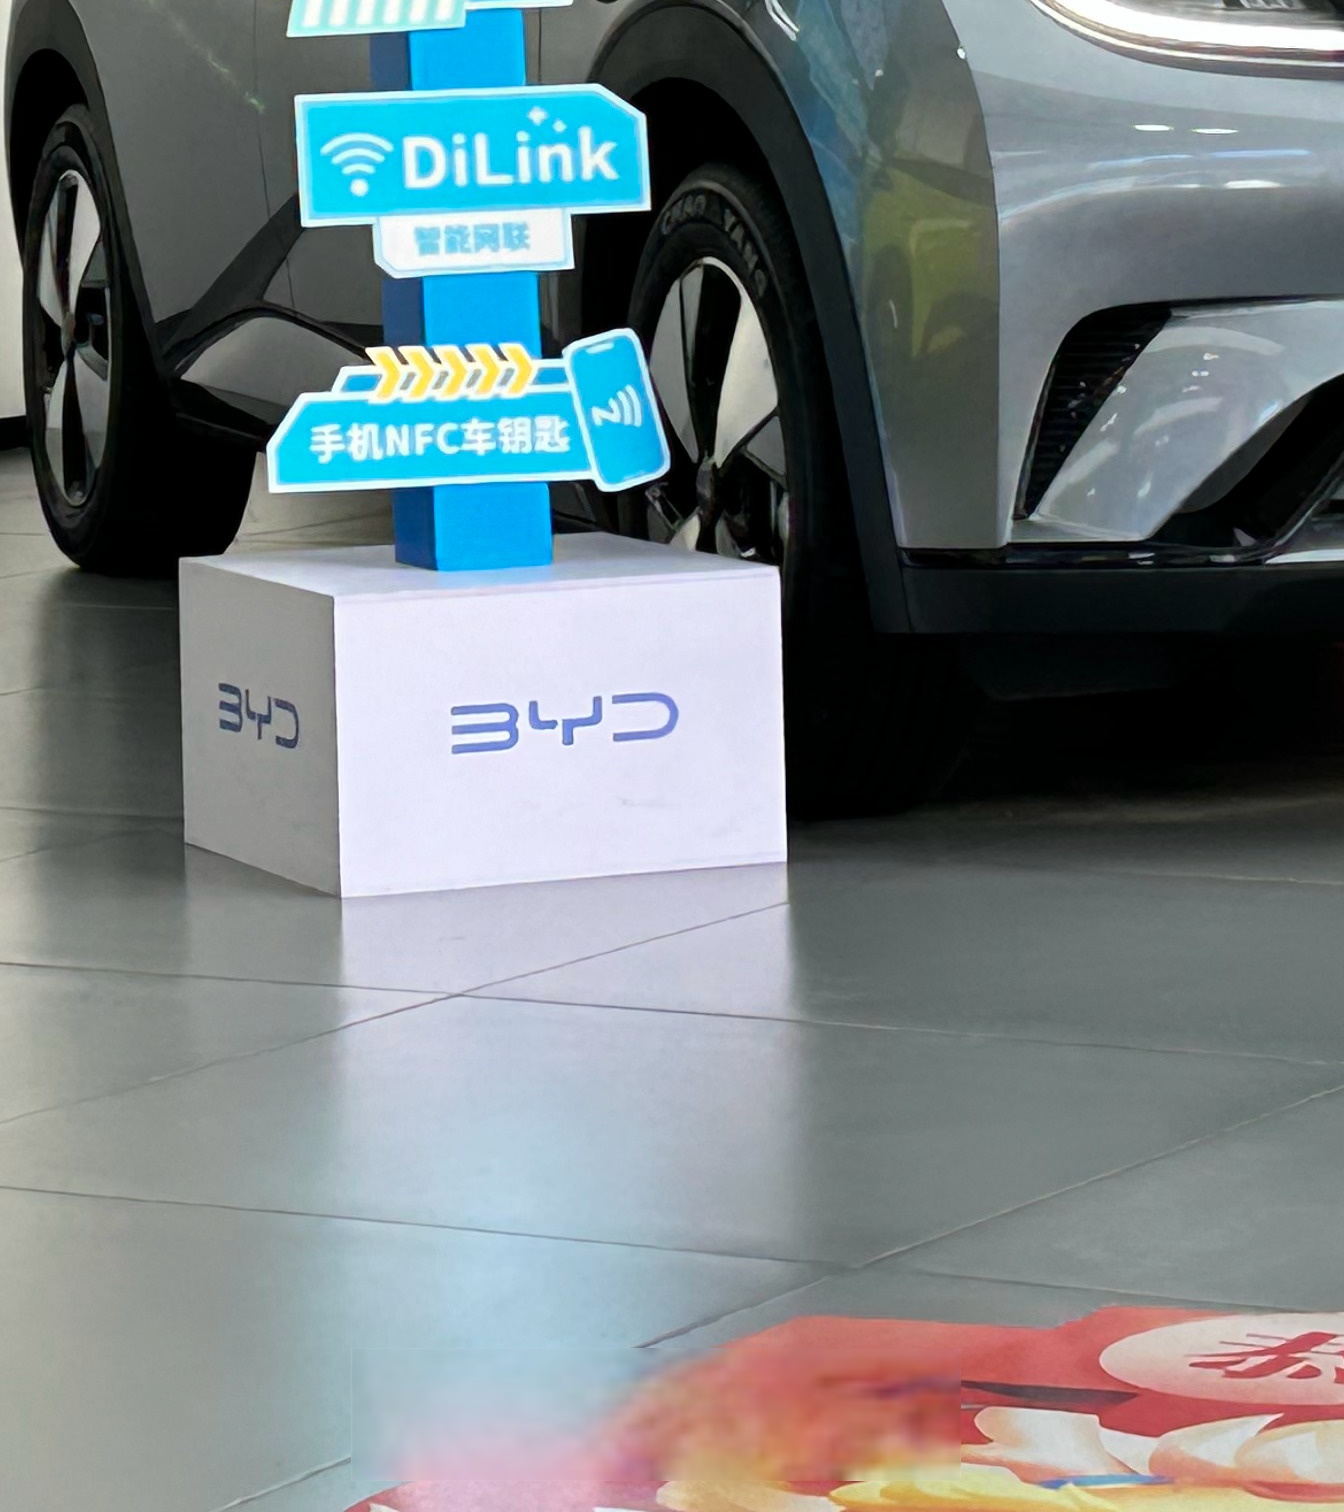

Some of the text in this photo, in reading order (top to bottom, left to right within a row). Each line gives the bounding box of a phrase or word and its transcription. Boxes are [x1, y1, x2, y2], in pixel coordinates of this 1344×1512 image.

[402, 125, 620, 190] DiLink
[413, 221, 531, 256] 智能网联
[309, 415, 571, 464] 手机NFC车钥匙
[217, 681, 301, 750] BYD
[450, 691, 680, 755] BYD
